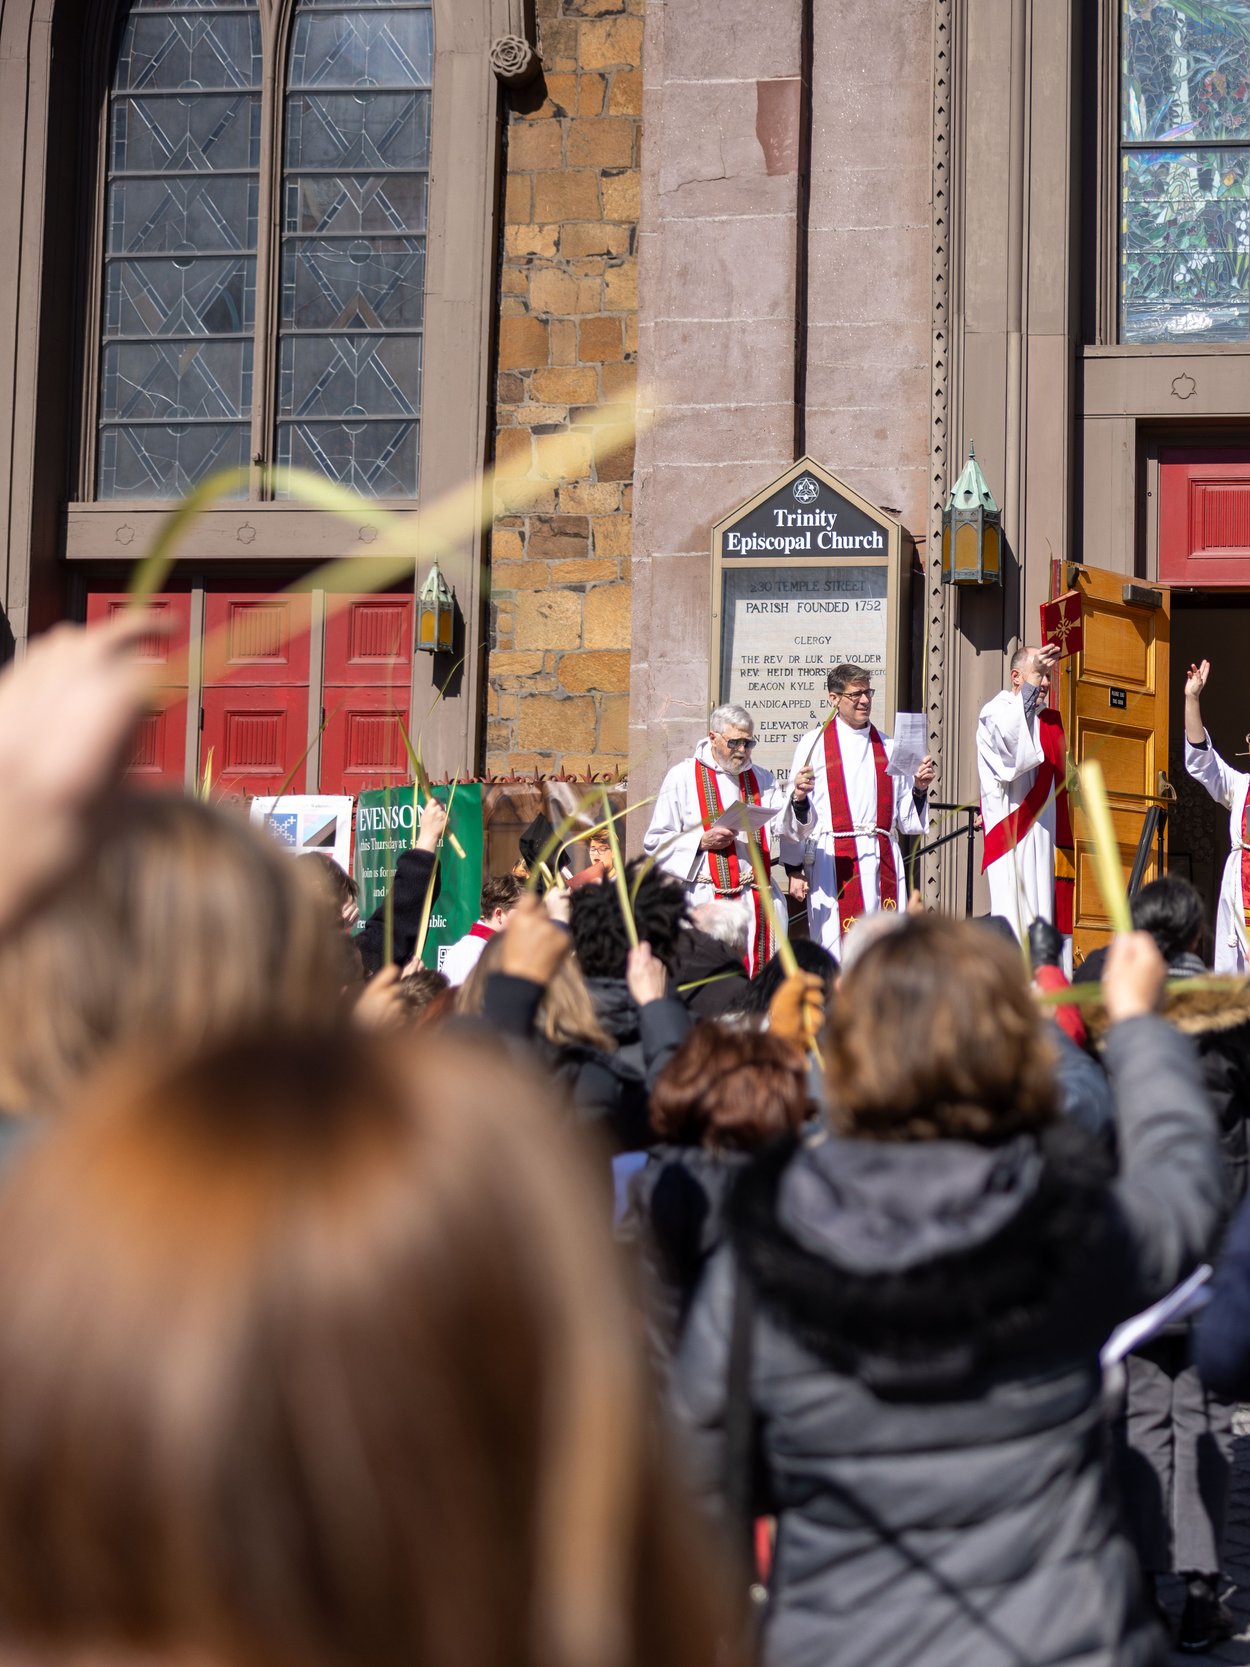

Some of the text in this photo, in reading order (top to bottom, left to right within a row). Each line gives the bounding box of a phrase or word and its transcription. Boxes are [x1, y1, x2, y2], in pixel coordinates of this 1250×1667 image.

[774, 508, 838, 530] Trinity
[727, 531, 883, 555] Episcopal Church
[750, 580, 865, 592] 230 TEMPLE STREET
[746, 600, 881, 613] PARISH FOUNDED 1752
[794, 636, 832, 645] CLERGY
[742, 655, 881, 664] THE REV DR LUK DE VOLDER
[767, 668, 793, 677] HEIDI
[748, 682, 785, 691] DEACON
[790, 682, 815, 691] KYLE
[744, 700, 811, 709] HANDICAPPED
[809, 710, 817, 719] &
[760, 721, 808, 730] ELEVATOR
[764, 734, 787, 743] LEFT
[399, 838, 407, 849] at
